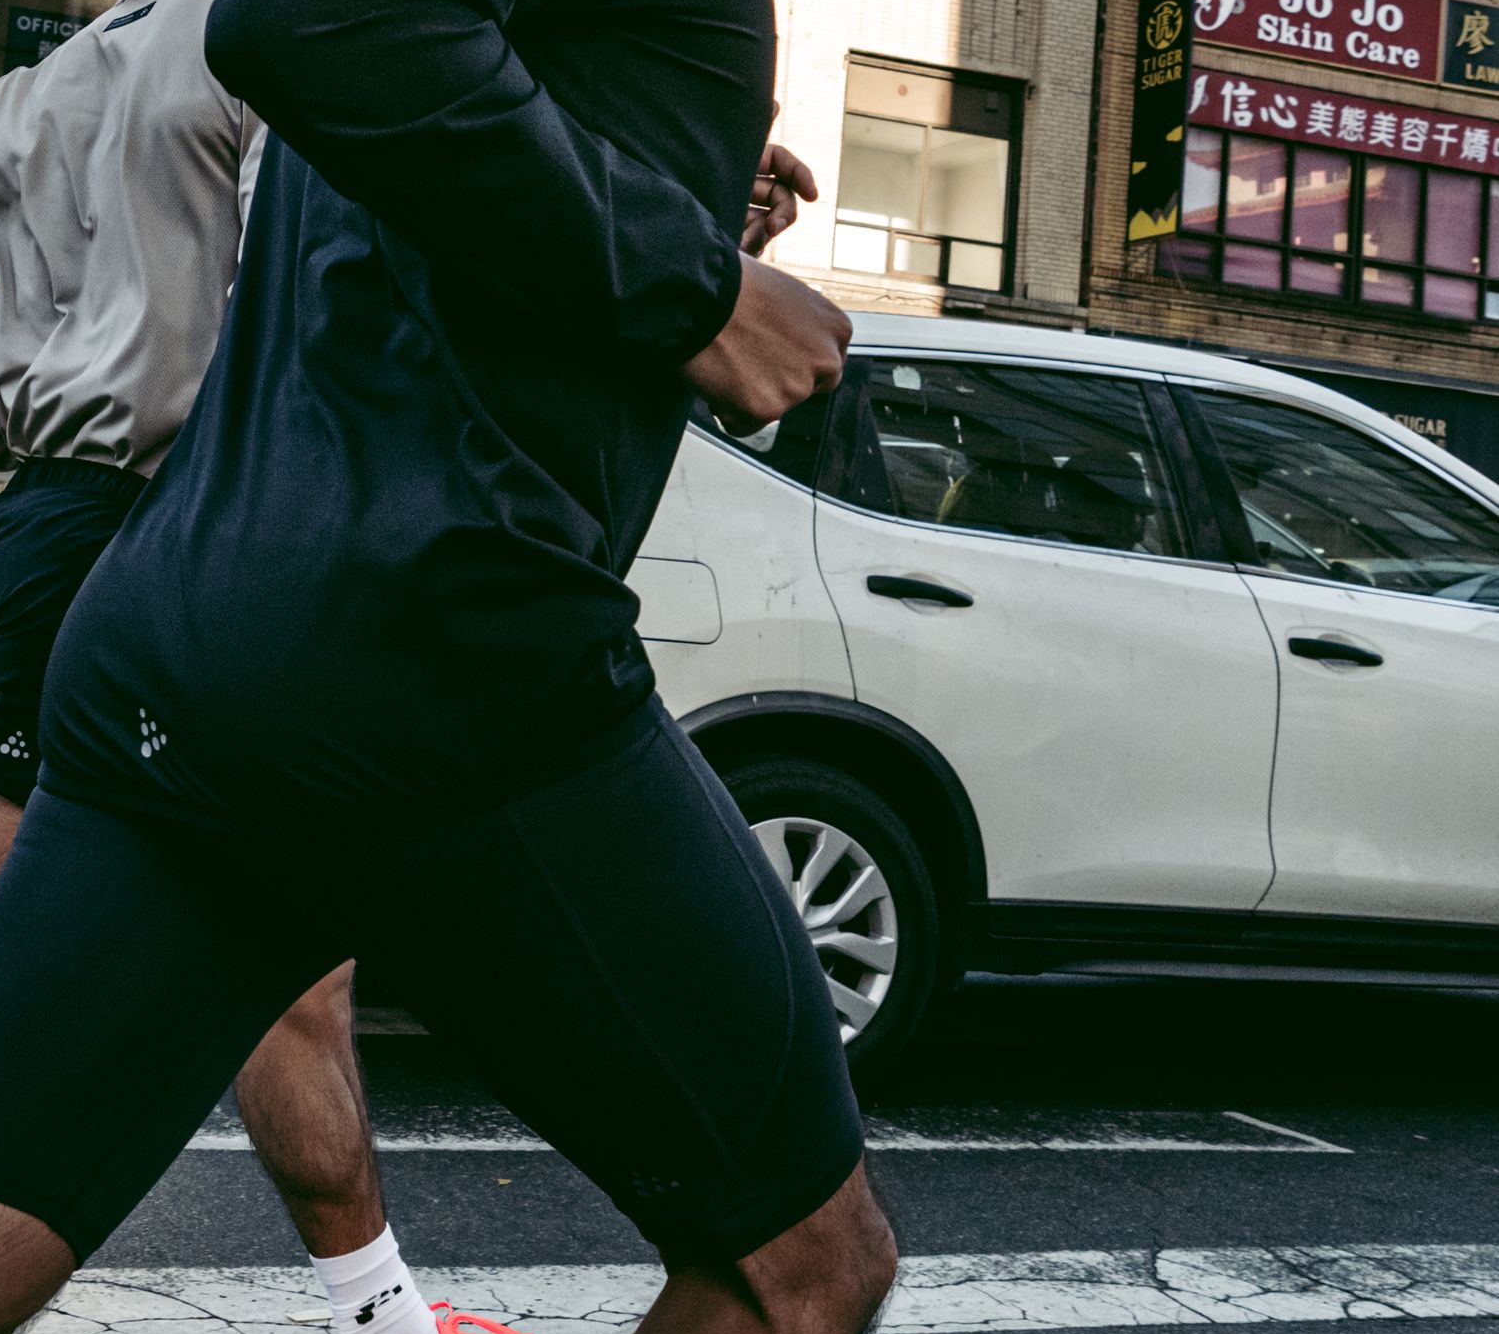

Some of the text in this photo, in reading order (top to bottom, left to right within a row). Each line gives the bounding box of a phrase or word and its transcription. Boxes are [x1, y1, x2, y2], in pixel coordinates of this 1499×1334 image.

[1257, 13, 1420, 68] Skin Care
[1141, 65, 1183, 90] SUGAR
[1142, 49, 1183, 73] TIGER
[1220, 80, 1299, 129] 信心
